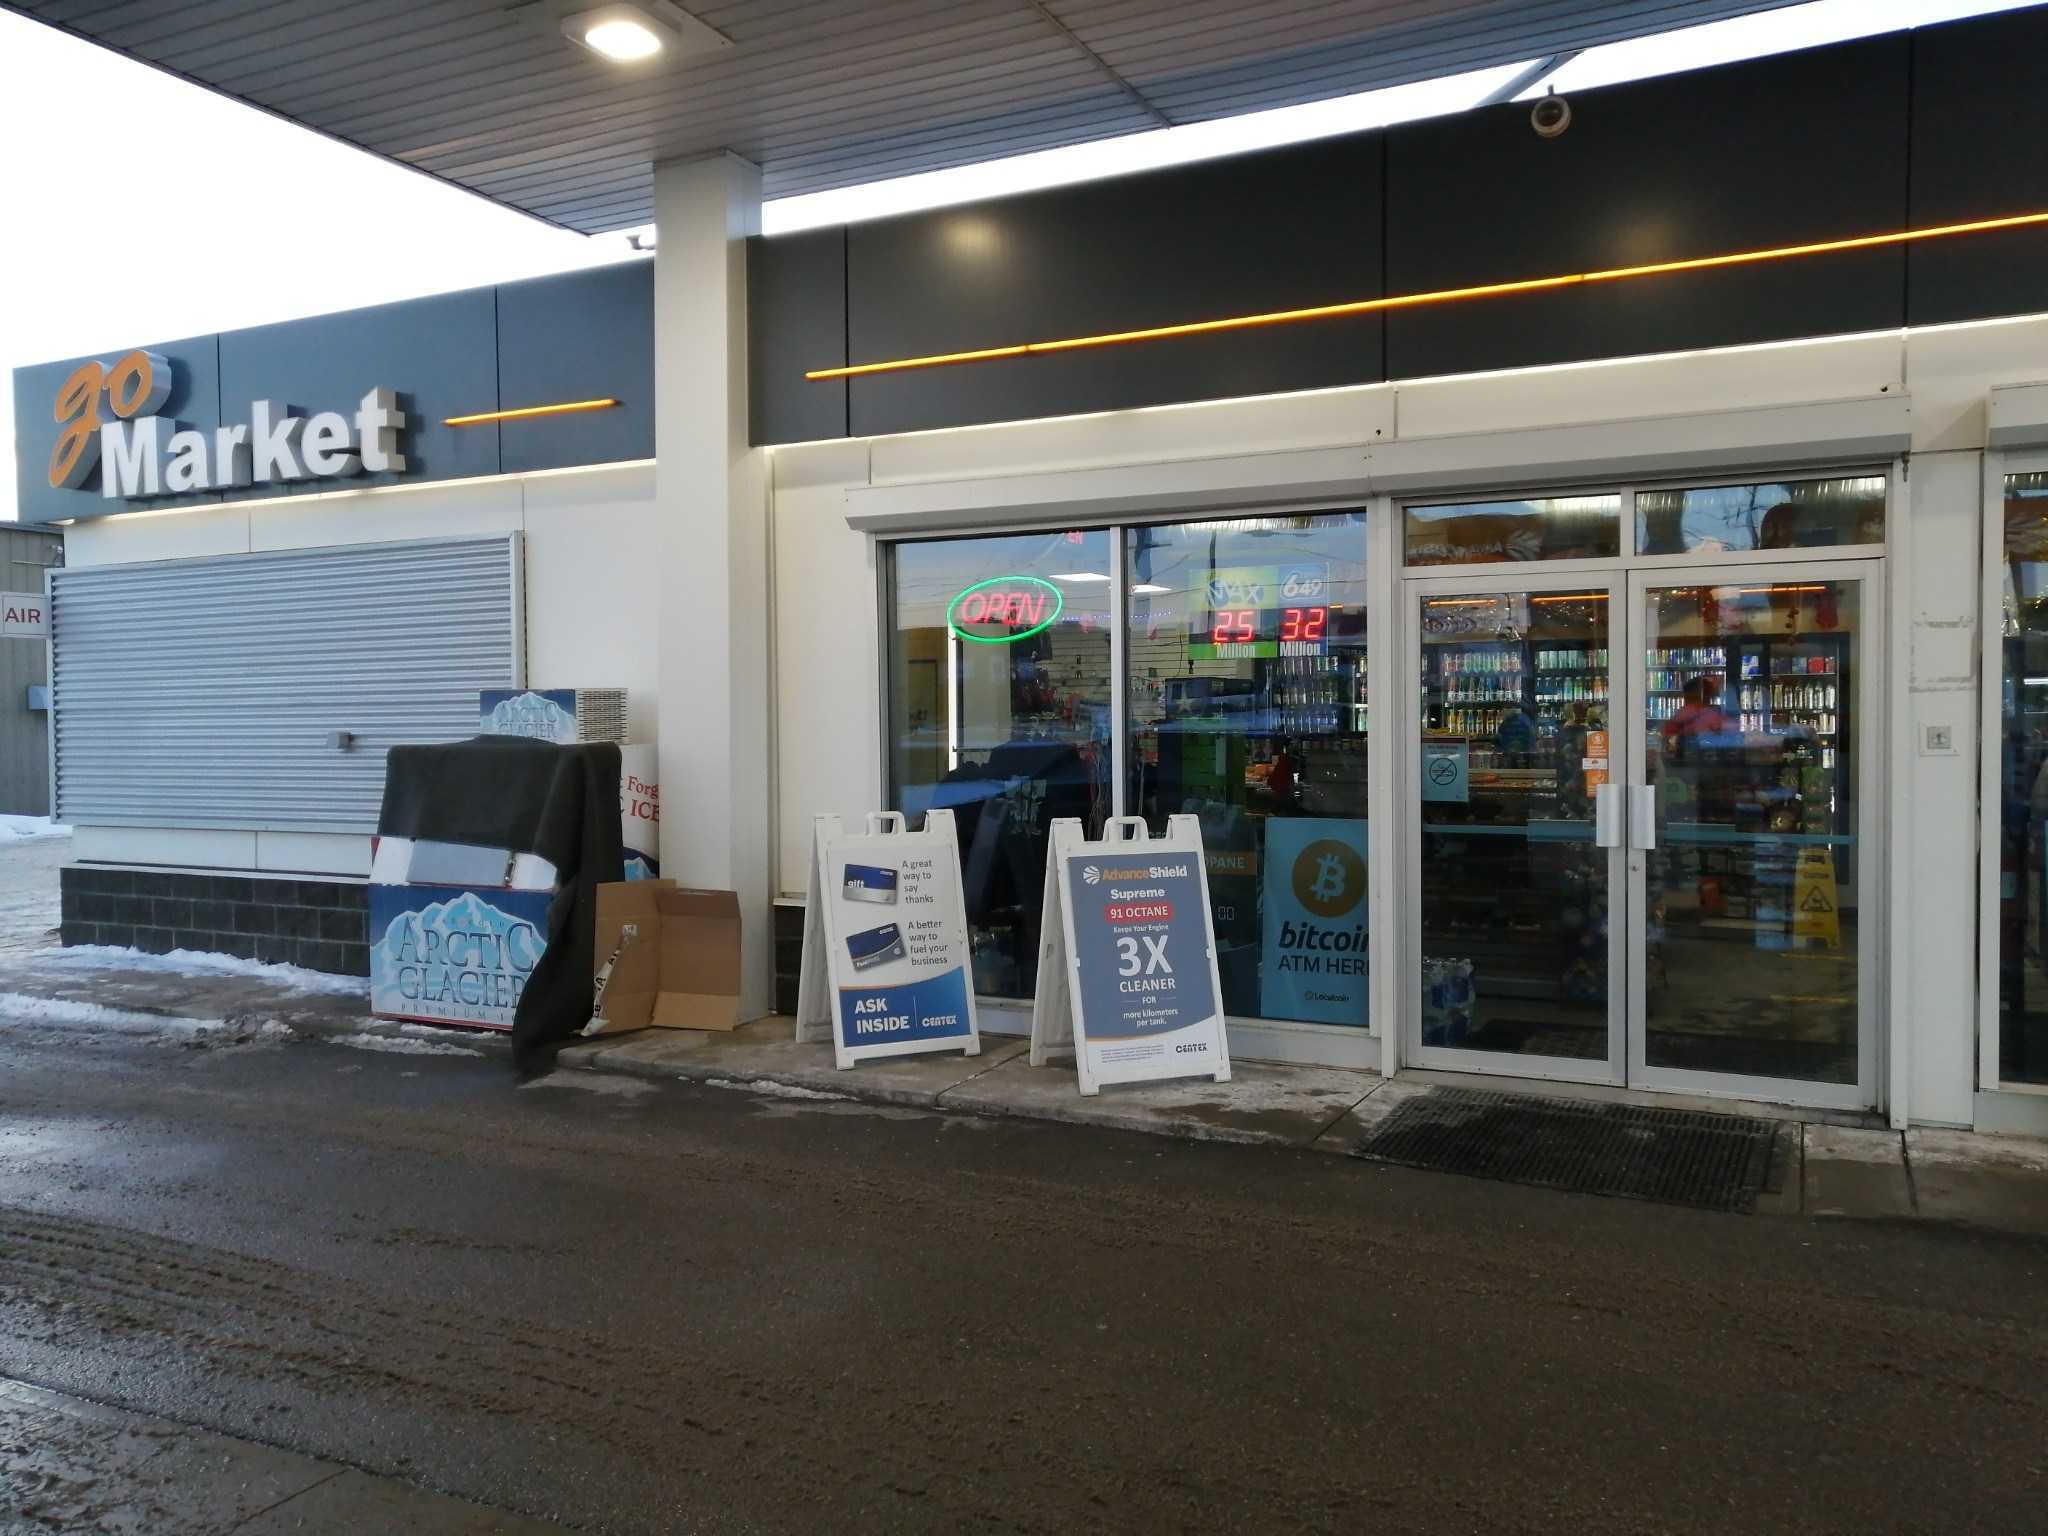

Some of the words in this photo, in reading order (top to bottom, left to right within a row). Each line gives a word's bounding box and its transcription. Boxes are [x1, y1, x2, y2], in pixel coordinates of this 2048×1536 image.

[49, 350, 165, 488] go
[100, 386, 406, 498] Market
[5, 607, 41, 624] AIR
[962, 591, 1045, 625] OPEN
[1214, 610, 1255, 642] 25
[1282, 608, 1325, 640] 32
[1216, 643, 1256, 658] Million
[1280, 641, 1321, 657] Million
[499, 702, 559, 724] ARCTIC
[498, 722, 558, 738] GLACIER
[910, 860, 932, 870] great
[903, 873, 920, 881] way
[922, 872, 932, 880] to
[847, 879, 865, 890] gift
[904, 885, 918, 894] say
[905, 895, 934, 904] thanks
[1110, 888, 1166, 901] Supreme
[1110, 908, 1124, 919] 91
[1125, 905, 1169, 918] OCTANE
[916, 920, 943, 929] better
[394, 915, 535, 973] ARCTIC
[909, 934, 927, 943] way
[928, 933, 938, 941] to
[910, 945, 927, 954] fuel
[928, 945, 948, 954] your
[1115, 934, 1174, 977] 3X
[911, 957, 948, 966] business
[1277, 954, 1320, 974] ATM
[1326, 957, 1369, 977] HER
[1119, 977, 1177, 993] CLEANER
[855, 998, 888, 1014] ASK
[1142, 996, 1157, 1005] FOR
[1123, 1011, 1142, 1020] more
[1142, 1007, 1179, 1018] kilometers
[856, 1015, 911, 1035] INSIDE
[1136, 1019, 1148, 1028] per
